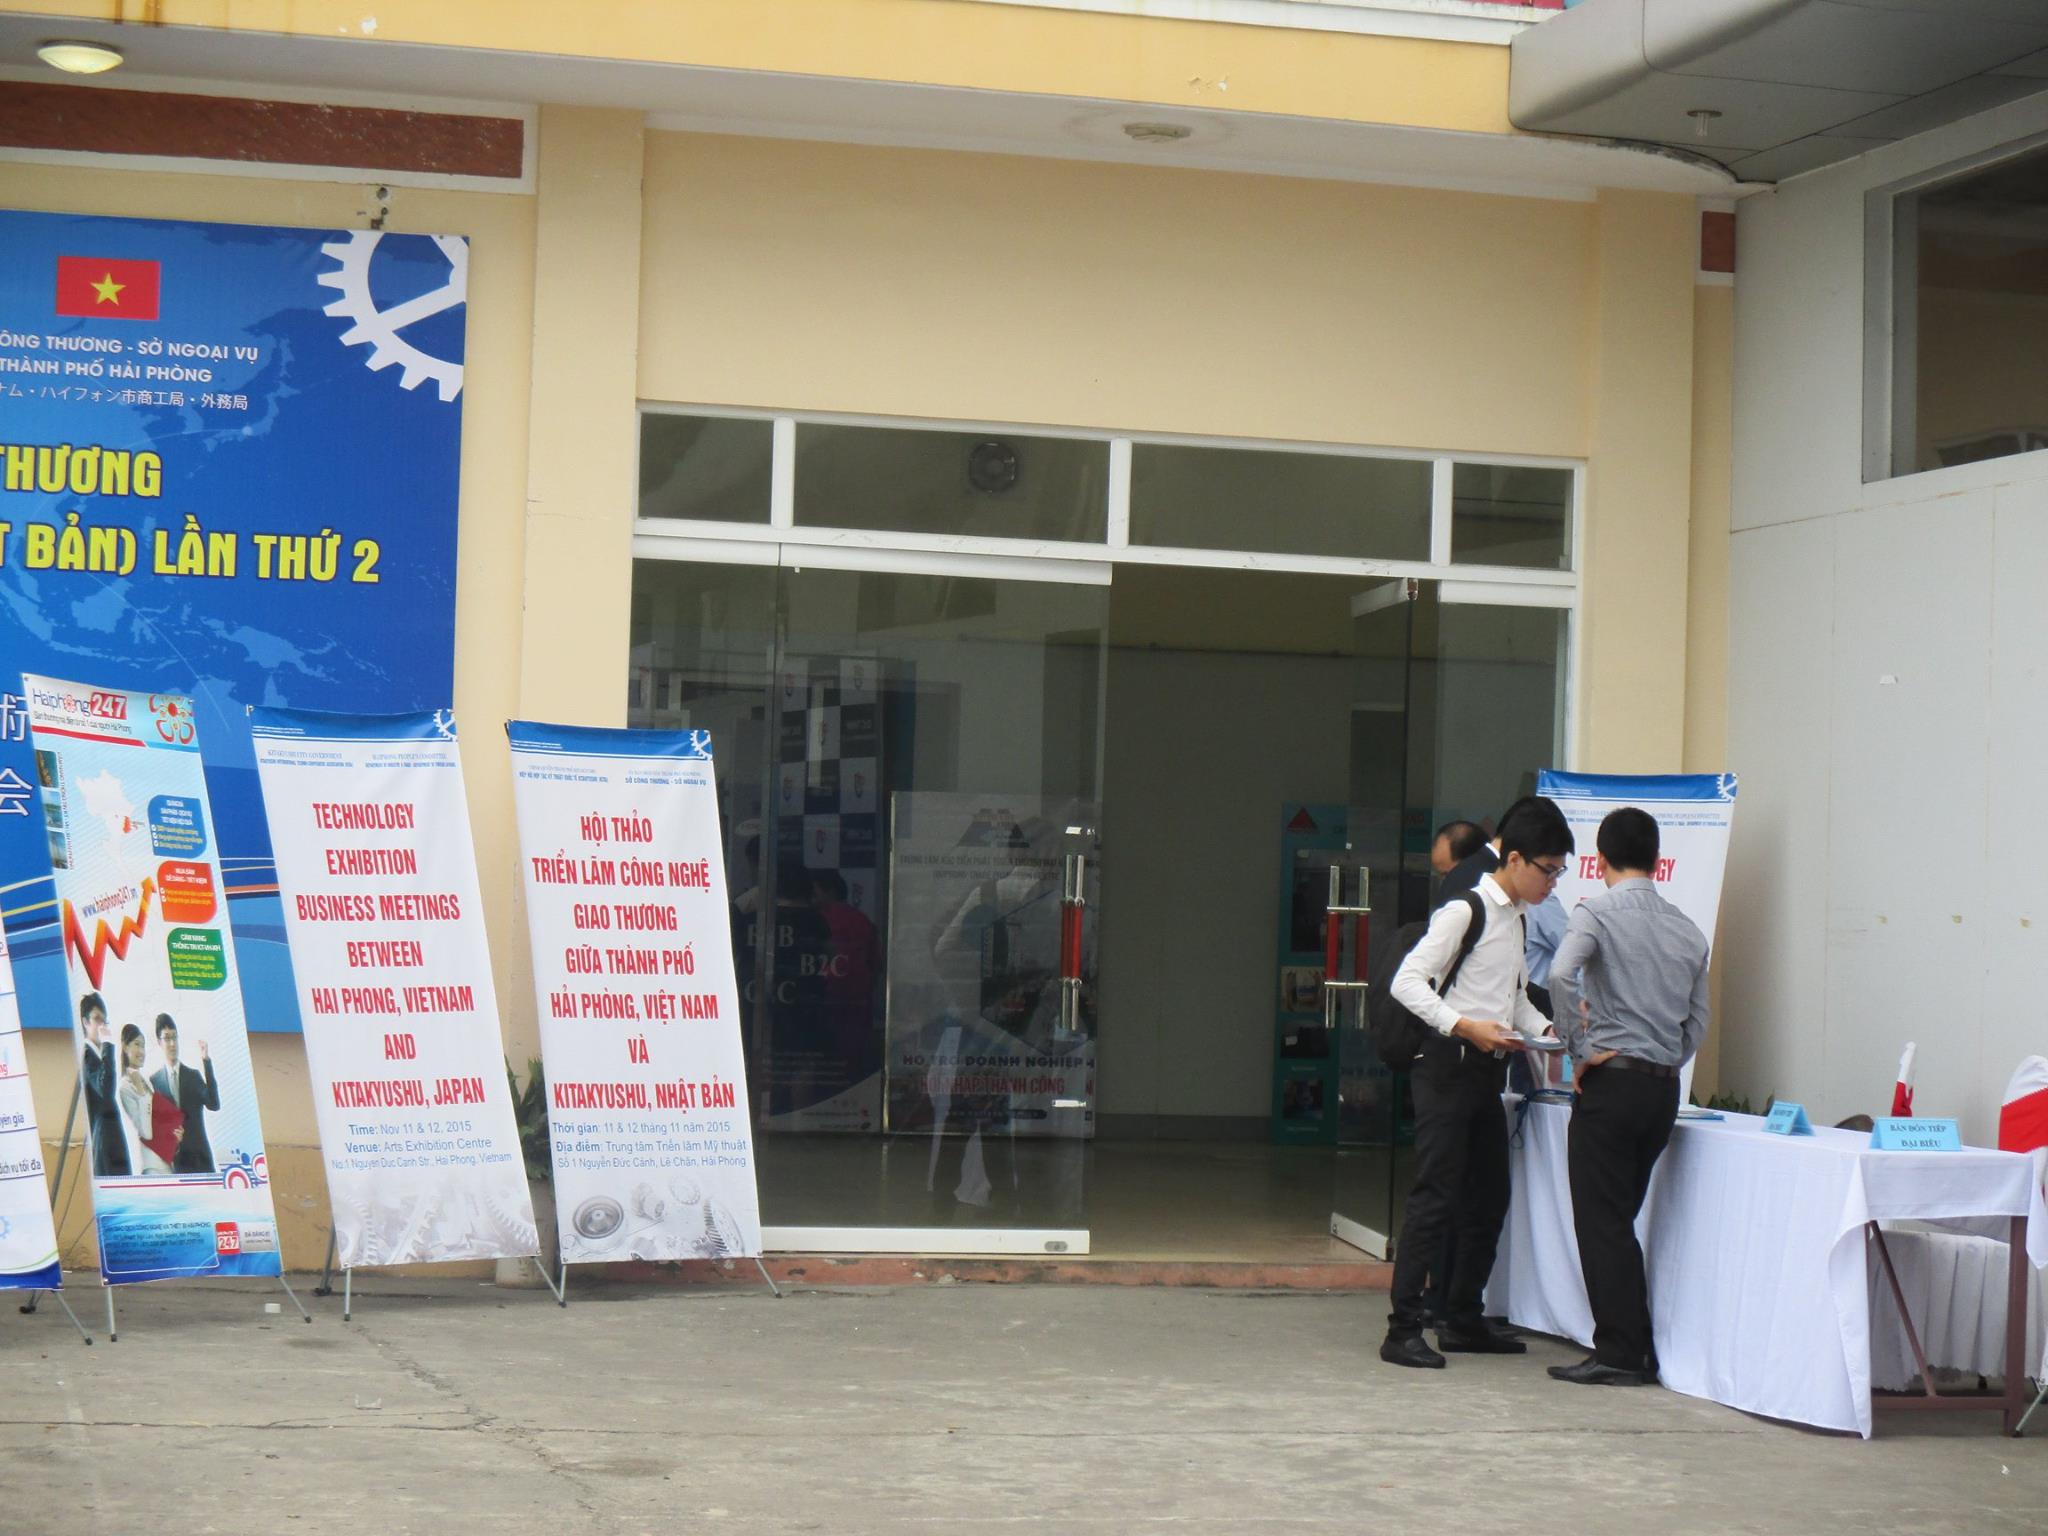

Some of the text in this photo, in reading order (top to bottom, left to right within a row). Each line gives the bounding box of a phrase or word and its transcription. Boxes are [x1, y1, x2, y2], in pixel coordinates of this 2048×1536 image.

[46, 334, 123, 354] THƯƠNG
[138, 336, 163, 355] SỞ
[168, 343, 229, 362] NGOẠI
[235, 346, 259, 364] VỤ
[65, 358, 104, 377] PHỐ
[109, 362, 140, 379] HẢI
[146, 366, 213, 383] PHÒNG
[0, 444, 162, 498] HƯƠNG
[26, 512, 137, 576] BẢN)
[153, 514, 237, 577] LẦN
[253, 529, 341, 581] THỨ
[352, 540, 380, 582] 2
[92, 693, 127, 718] 247
[312, 803, 415, 829] TECHNOLOGY
[580, 809, 653, 847] HỘI THẢO
[326, 849, 417, 875] EXHIBITION
[532, 849, 711, 893] TRIỂN LÃM CÔNG NGHỆ
[296, 894, 460, 921] BUSINESS MEETINGS
[574, 903, 678, 931] GIAO THƯƠNG
[347, 941, 423, 967] BETWEEN
[565, 941, 695, 975] GIỮA THÀNH PHỐ
[800, 953, 849, 977] B2C
[312, 985, 474, 1017] HAI PHONG, VIETNAM
[550, 984, 719, 1025] HẢI PHÒNG, VIỆT NAM
[384, 1034, 416, 1060] AND
[627, 1033, 650, 1064] VÀ
[332, 1077, 485, 1109] KITAKYUSHU, JAPAN
[554, 1074, 735, 1114] KITAKYUSHU, NHẬT BẢN
[348, 1123, 378, 1136] Time:
[380, 1123, 400, 1136] Nov
[403, 1122, 413, 1134] 11
[416, 1122, 425, 1134] &
[446, 1120, 472, 1133] 2015
[604, 1122, 614, 1133] 11
[617, 1122, 625, 1133] &
[627, 1122, 639, 1133] 12
[670, 1122, 680, 1133] 11
[707, 1121, 731, 1133] 2015
[345, 1137, 492, 1154] Venue: Arts Exhibition Centre
[479, 1151, 512, 1164] Vietnam
[605, 1140, 633, 1155] Trung
